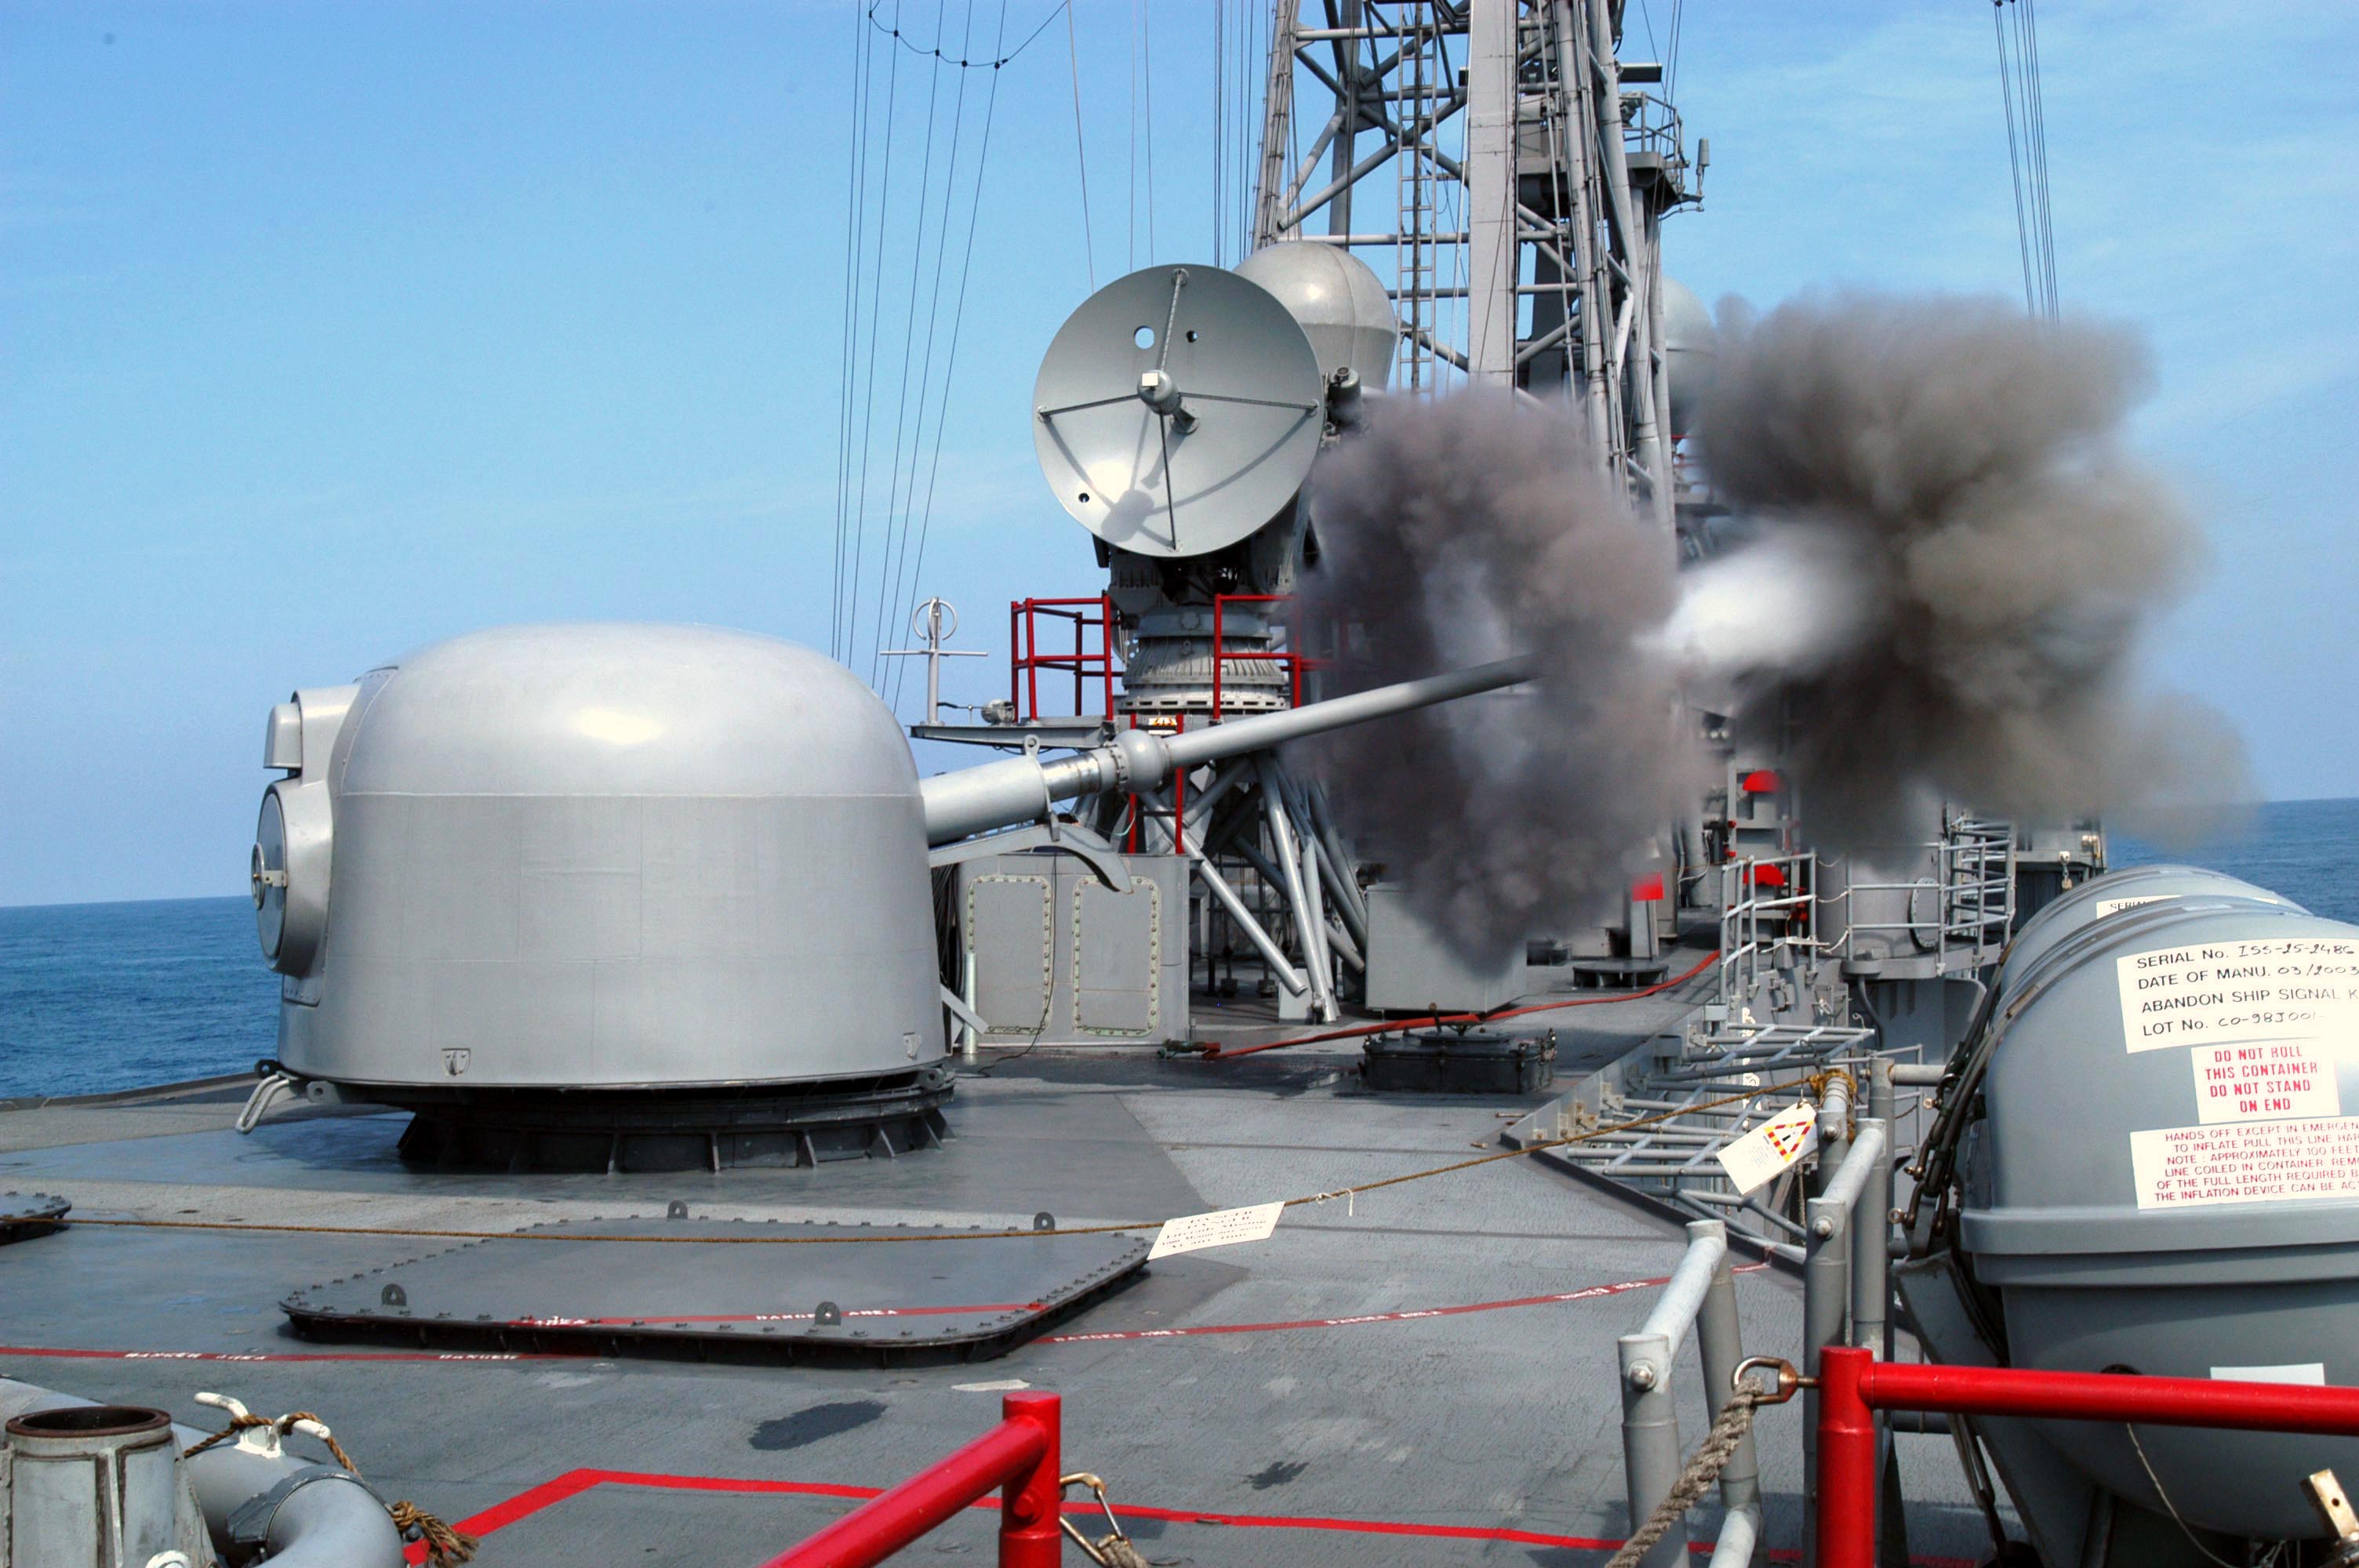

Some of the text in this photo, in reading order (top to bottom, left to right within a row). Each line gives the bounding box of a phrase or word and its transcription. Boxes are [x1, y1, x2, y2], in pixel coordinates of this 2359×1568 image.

[2138, 952, 2194, 968] SERIAL
[2202, 949, 2229, 960] No.
[2139, 974, 2178, 989] DATE
[2186, 971, 2208, 982] OF
[2217, 966, 2270, 979] MANU.
[2143, 989, 2359, 1013] ABANDON SHIP SIGNAL K
[2143, 1021, 2174, 1036] LOT
[2182, 1019, 2208, 1030] No.
[2215, 1046, 2303, 1062] DO NOT ROLL
[2205, 1062, 2317, 1080] THIS CONTAINER
[2210, 1080, 2310, 1097] DO NOT STAND
[2240, 1098, 2290, 1112] ON END
[2165, 1131, 2205, 1142] HANDS
[2210, 1129, 2230, 1138] OFF
[2237, 1126, 2282, 1136] EXCEPT
[2175, 1144, 2188, 1152] TO
[2194, 1140, 2238, 1151] INFLATE
[2244, 1138, 2271, 1147] PULL
[2277, 1136, 2303, 1145] THIS
[2308, 1134, 2332, 1144] LINE
[2168, 1155, 2196, 1165] NOTE
[2211, 1149, 2300, 1161] APPROXIMATELY
[2332, 1145, 2359, 1154] FEET
[2165, 1167, 2189, 1177] LINE
[2195, 1164, 2237, 1174] COILED
[2259, 1159, 2323, 1171] CONTAINER
[2157, 1181, 2172, 1189] OF
[2177, 1178, 2198, 1188] THE
[2204, 1177, 2231, 1185] FULL
[2237, 1173, 2281, 1184] LENGTH
[2287, 1170, 2345, 1181] REQUIRED
[2155, 1192, 2175, 1202] THE
[2182, 1188, 2239, 1200] INFLATION
[2245, 1185, 2285, 1196] DEVICE
[2321, 1182, 2334, 1191] BE
